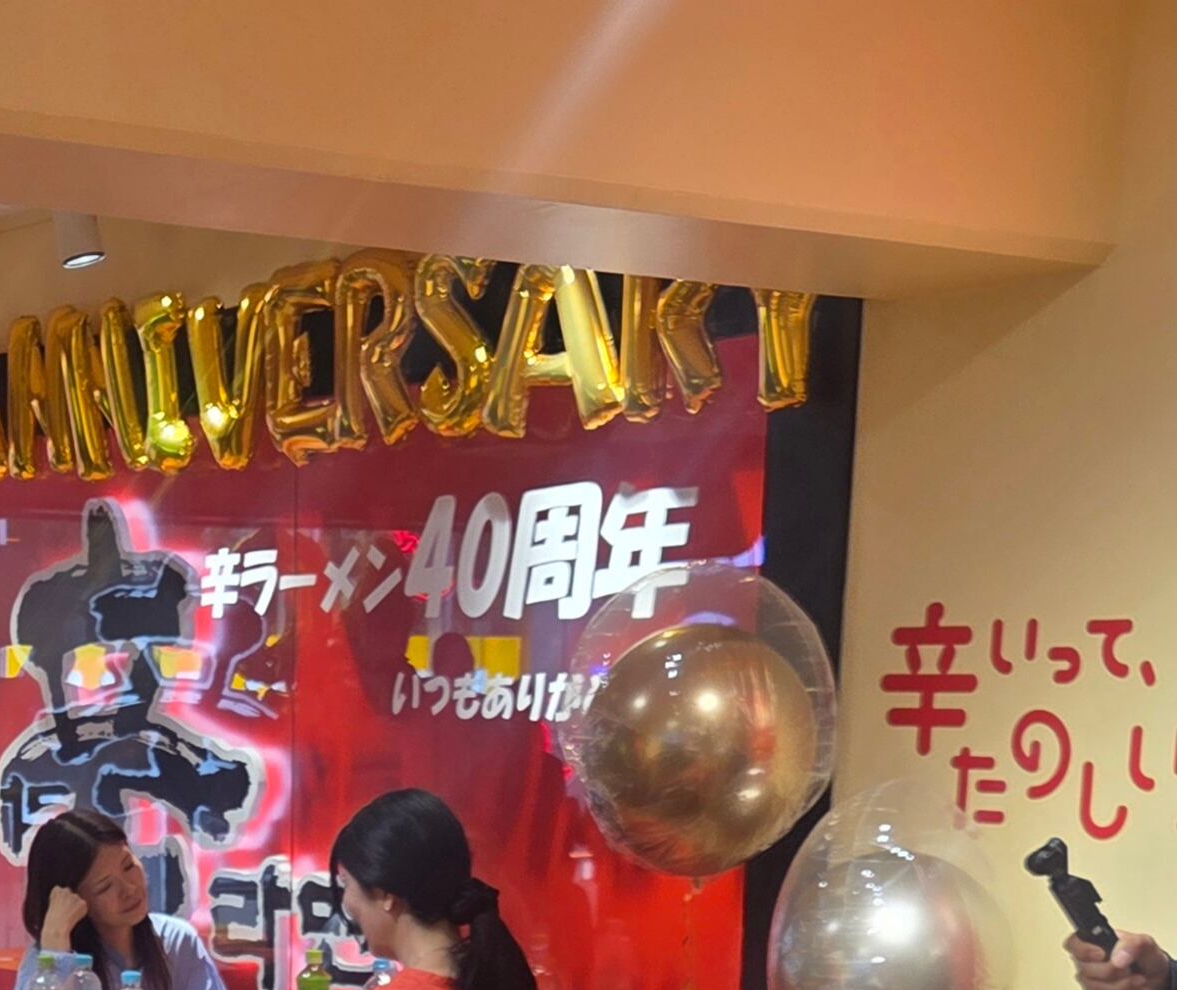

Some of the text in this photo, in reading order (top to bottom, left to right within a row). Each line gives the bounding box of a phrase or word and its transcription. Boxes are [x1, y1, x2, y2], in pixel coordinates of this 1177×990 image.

[200, 481, 699, 619] 辛ラーメン40周年
[391, 671, 605, 722] いつもありが
[879, 601, 1156, 756] 辛いって、
